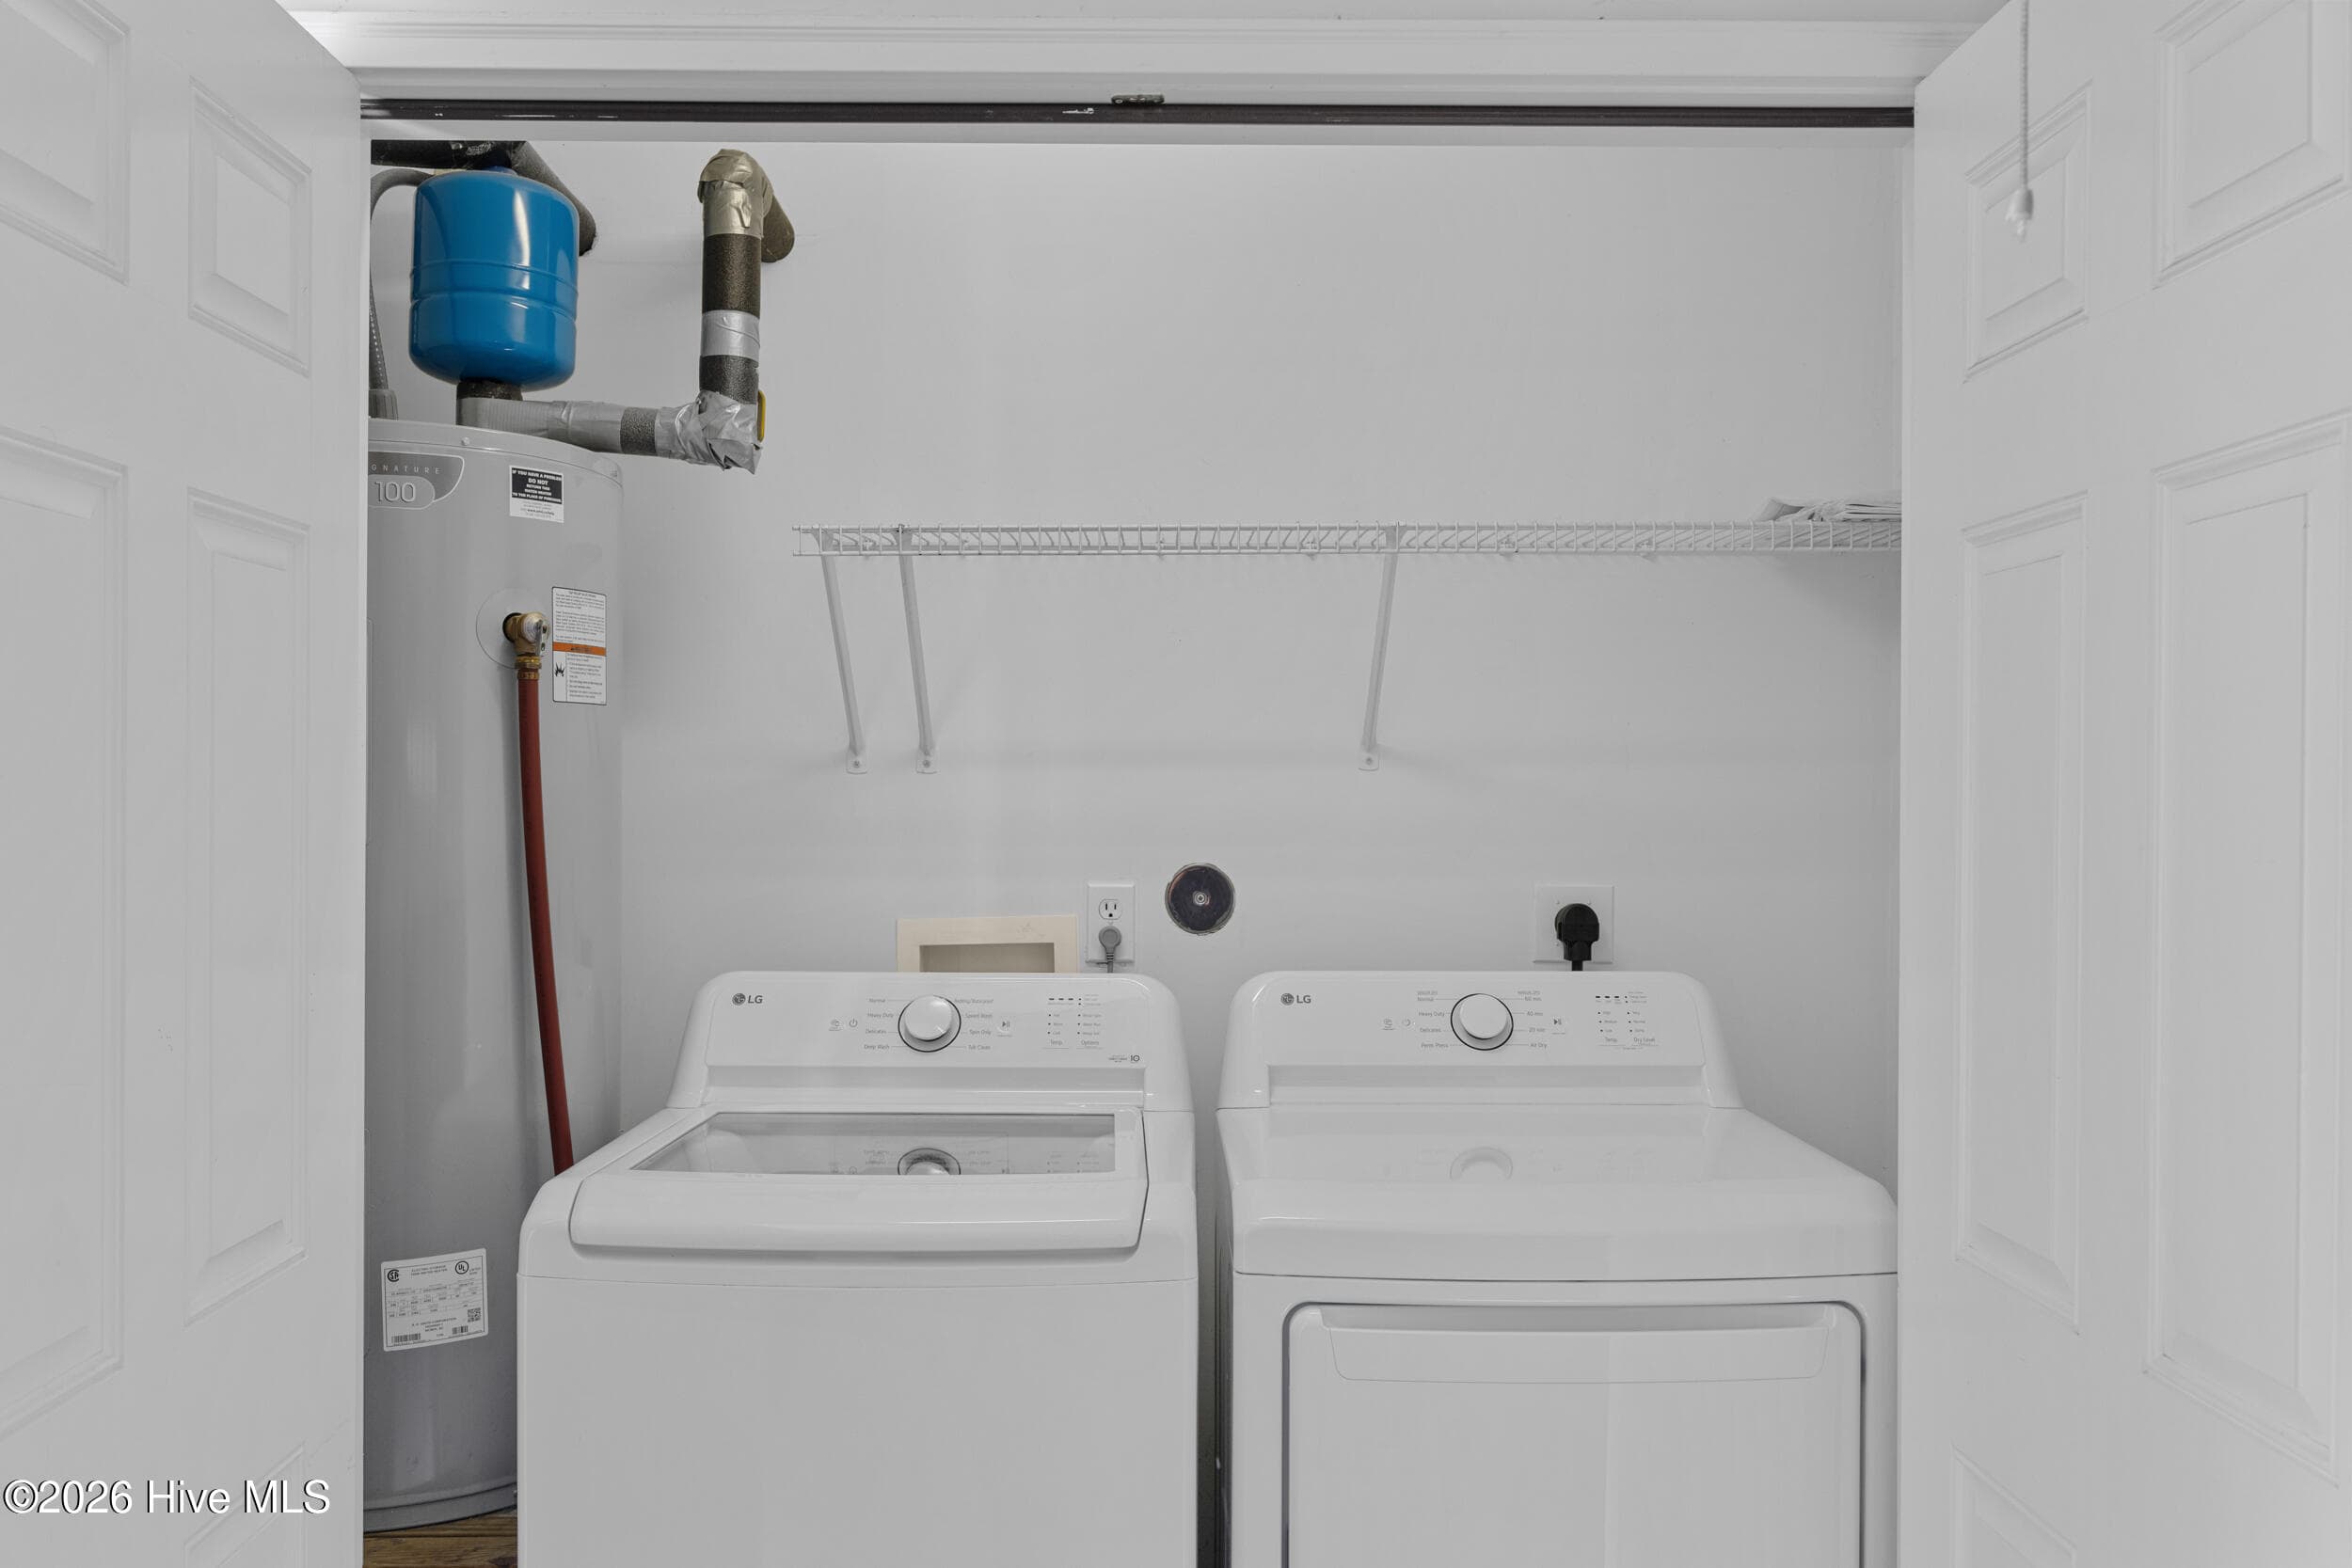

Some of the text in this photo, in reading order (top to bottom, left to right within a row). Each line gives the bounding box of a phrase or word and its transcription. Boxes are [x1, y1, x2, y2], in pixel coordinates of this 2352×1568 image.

[372, 464, 441, 475] GNATURE
[374, 481, 416, 502] 100
[748, 995, 763, 1004] LG
[1296, 995, 1311, 1004] LG
